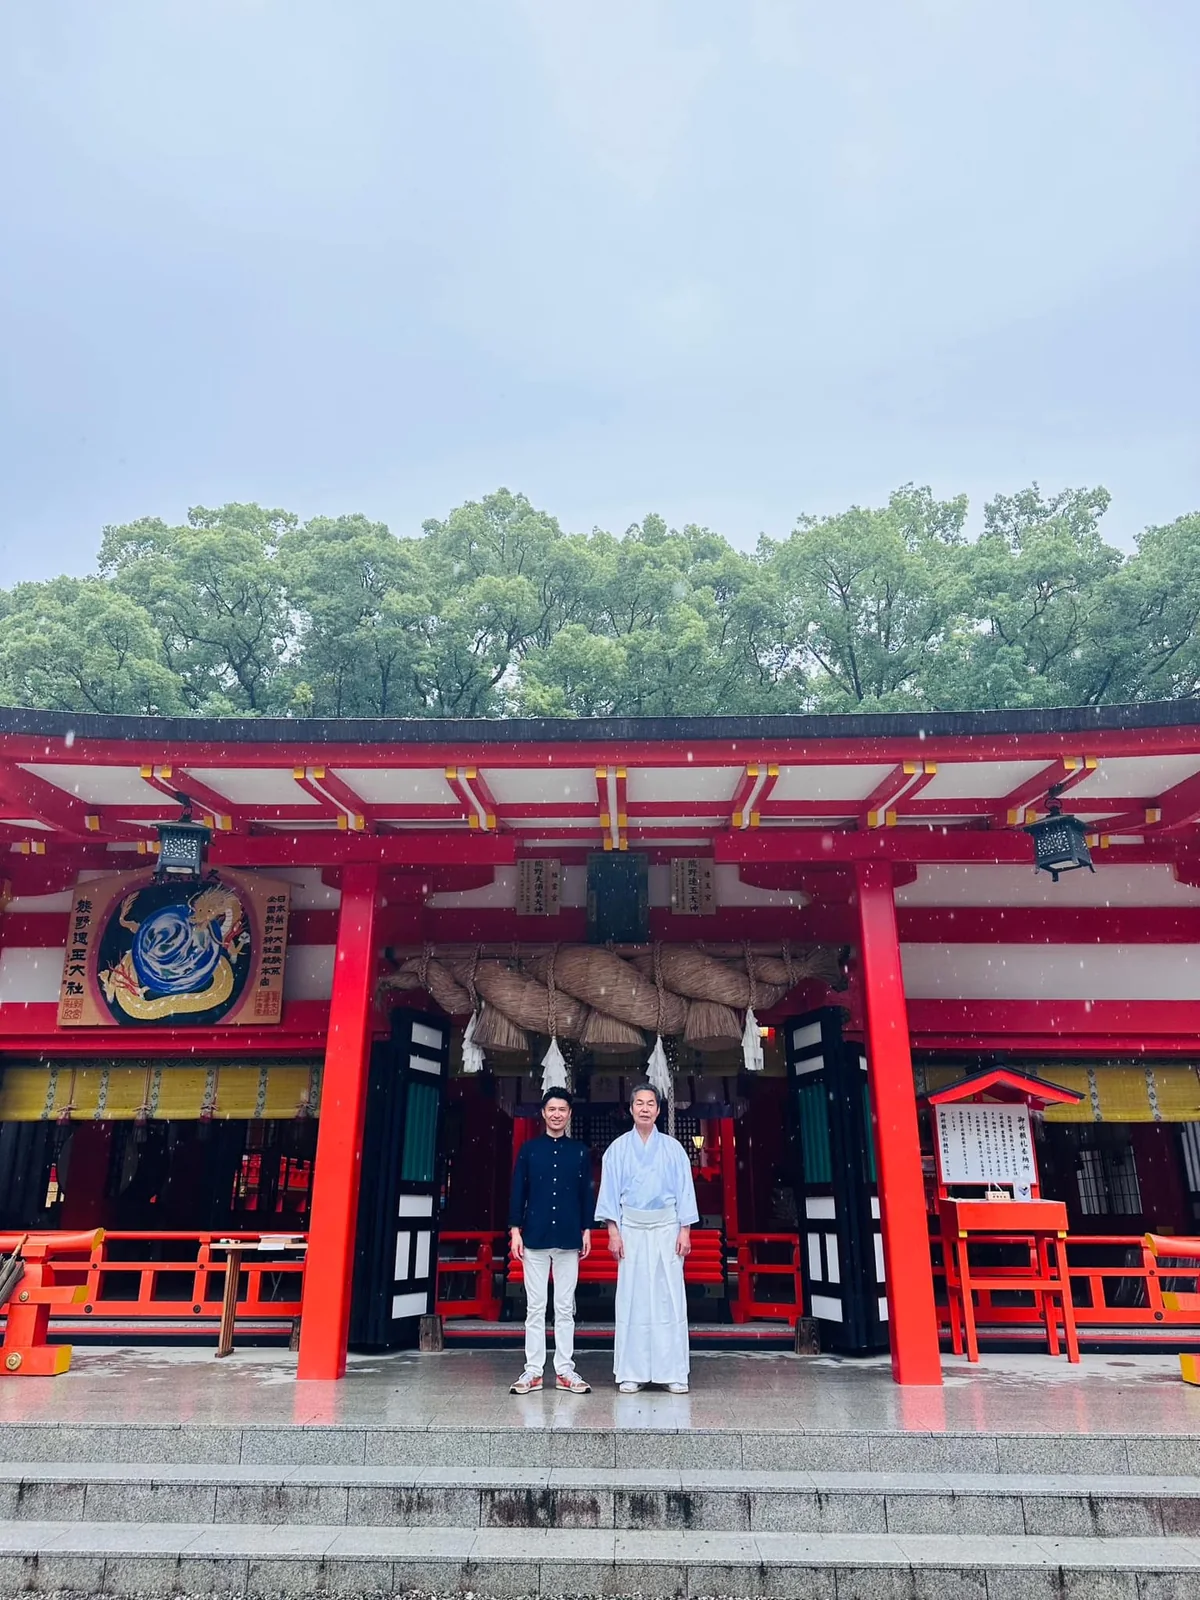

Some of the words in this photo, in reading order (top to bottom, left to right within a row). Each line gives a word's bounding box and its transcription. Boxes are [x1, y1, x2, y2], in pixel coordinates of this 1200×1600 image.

[65, 899, 93, 996] 熊野速玉大社
